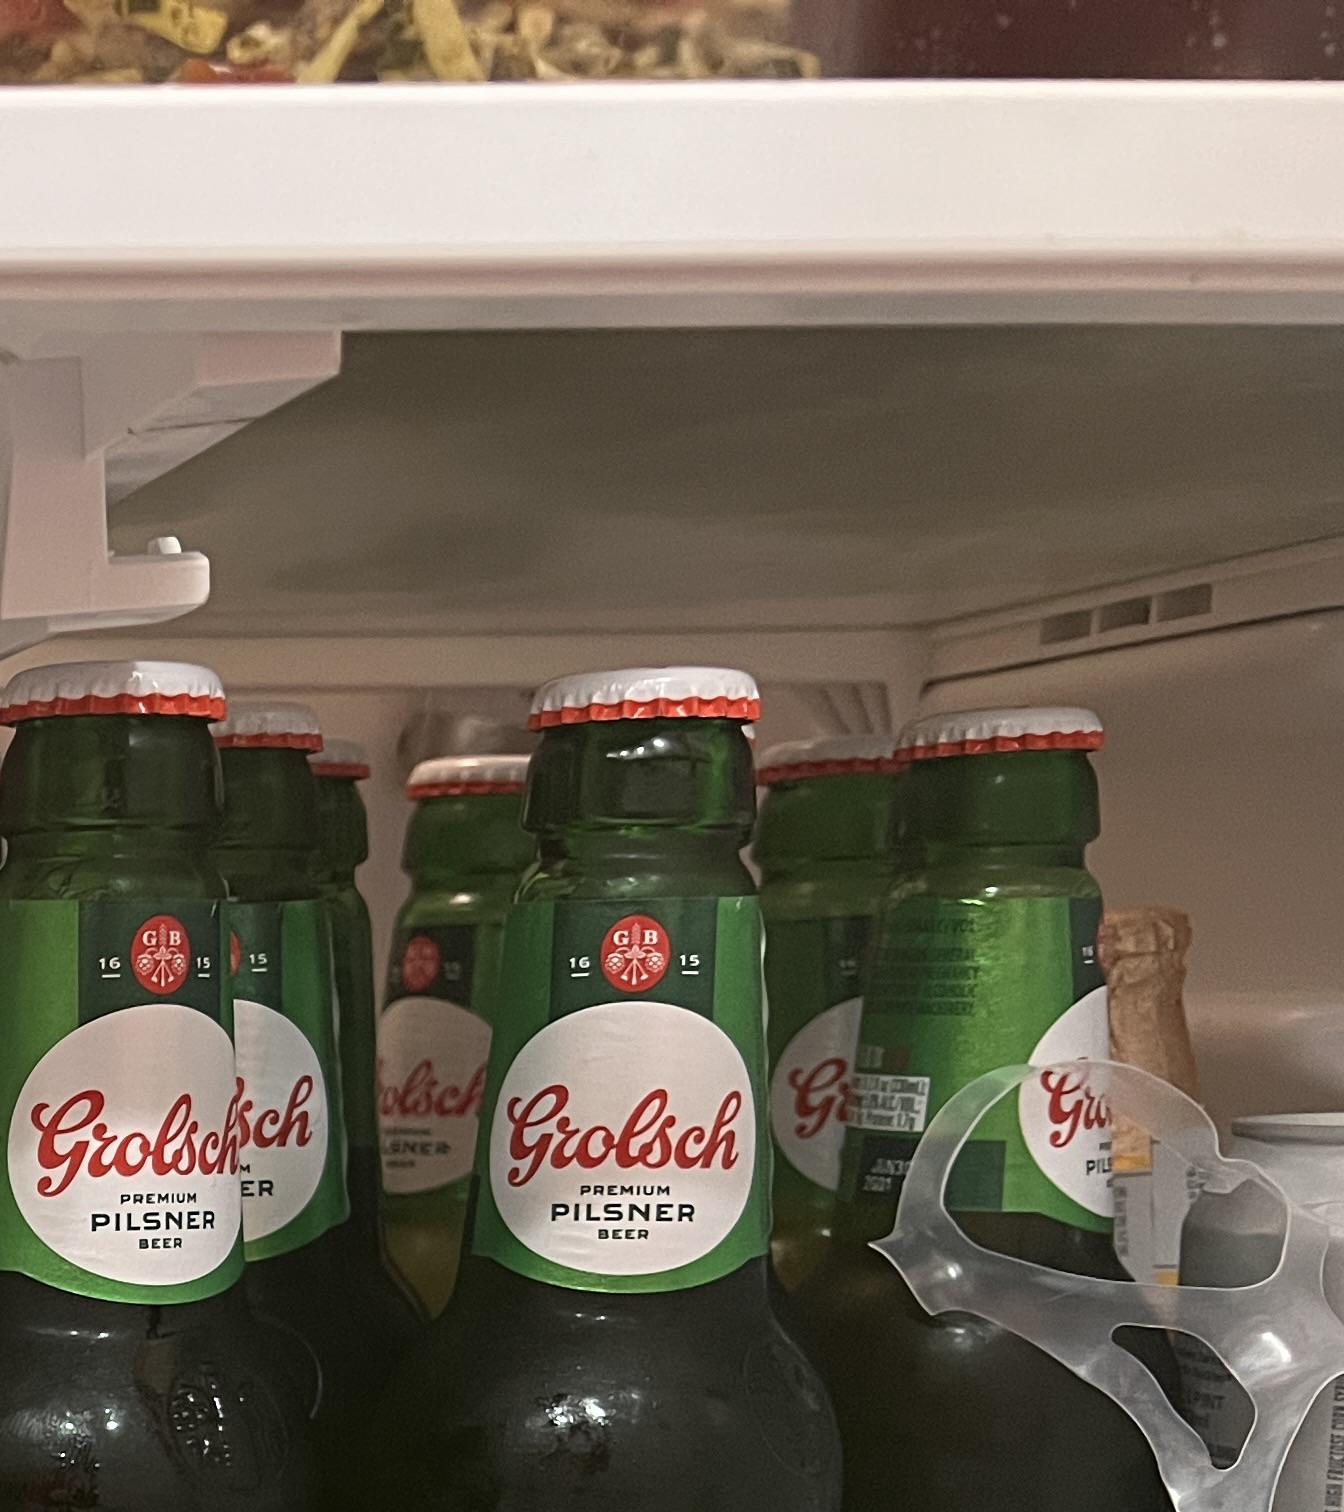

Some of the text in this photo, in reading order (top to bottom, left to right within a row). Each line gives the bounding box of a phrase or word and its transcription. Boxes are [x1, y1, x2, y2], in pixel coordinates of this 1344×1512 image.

[99, 957, 211, 970] 16 15
[249, 953, 268, 965] 15
[569, 955, 700, 969] 16 15
[507, 1084, 742, 1188] Grolsch
[31, 1090, 241, 1197] Grolsch
[580, 1185, 671, 1197] PREMIUM
[120, 1192, 198, 1205] PREMIUM
[550, 1203, 695, 1222] PILSNER
[91, 1210, 215, 1232] PILSNER
[597, 1229, 650, 1241] BEER
[138, 1237, 183, 1249] BEER
